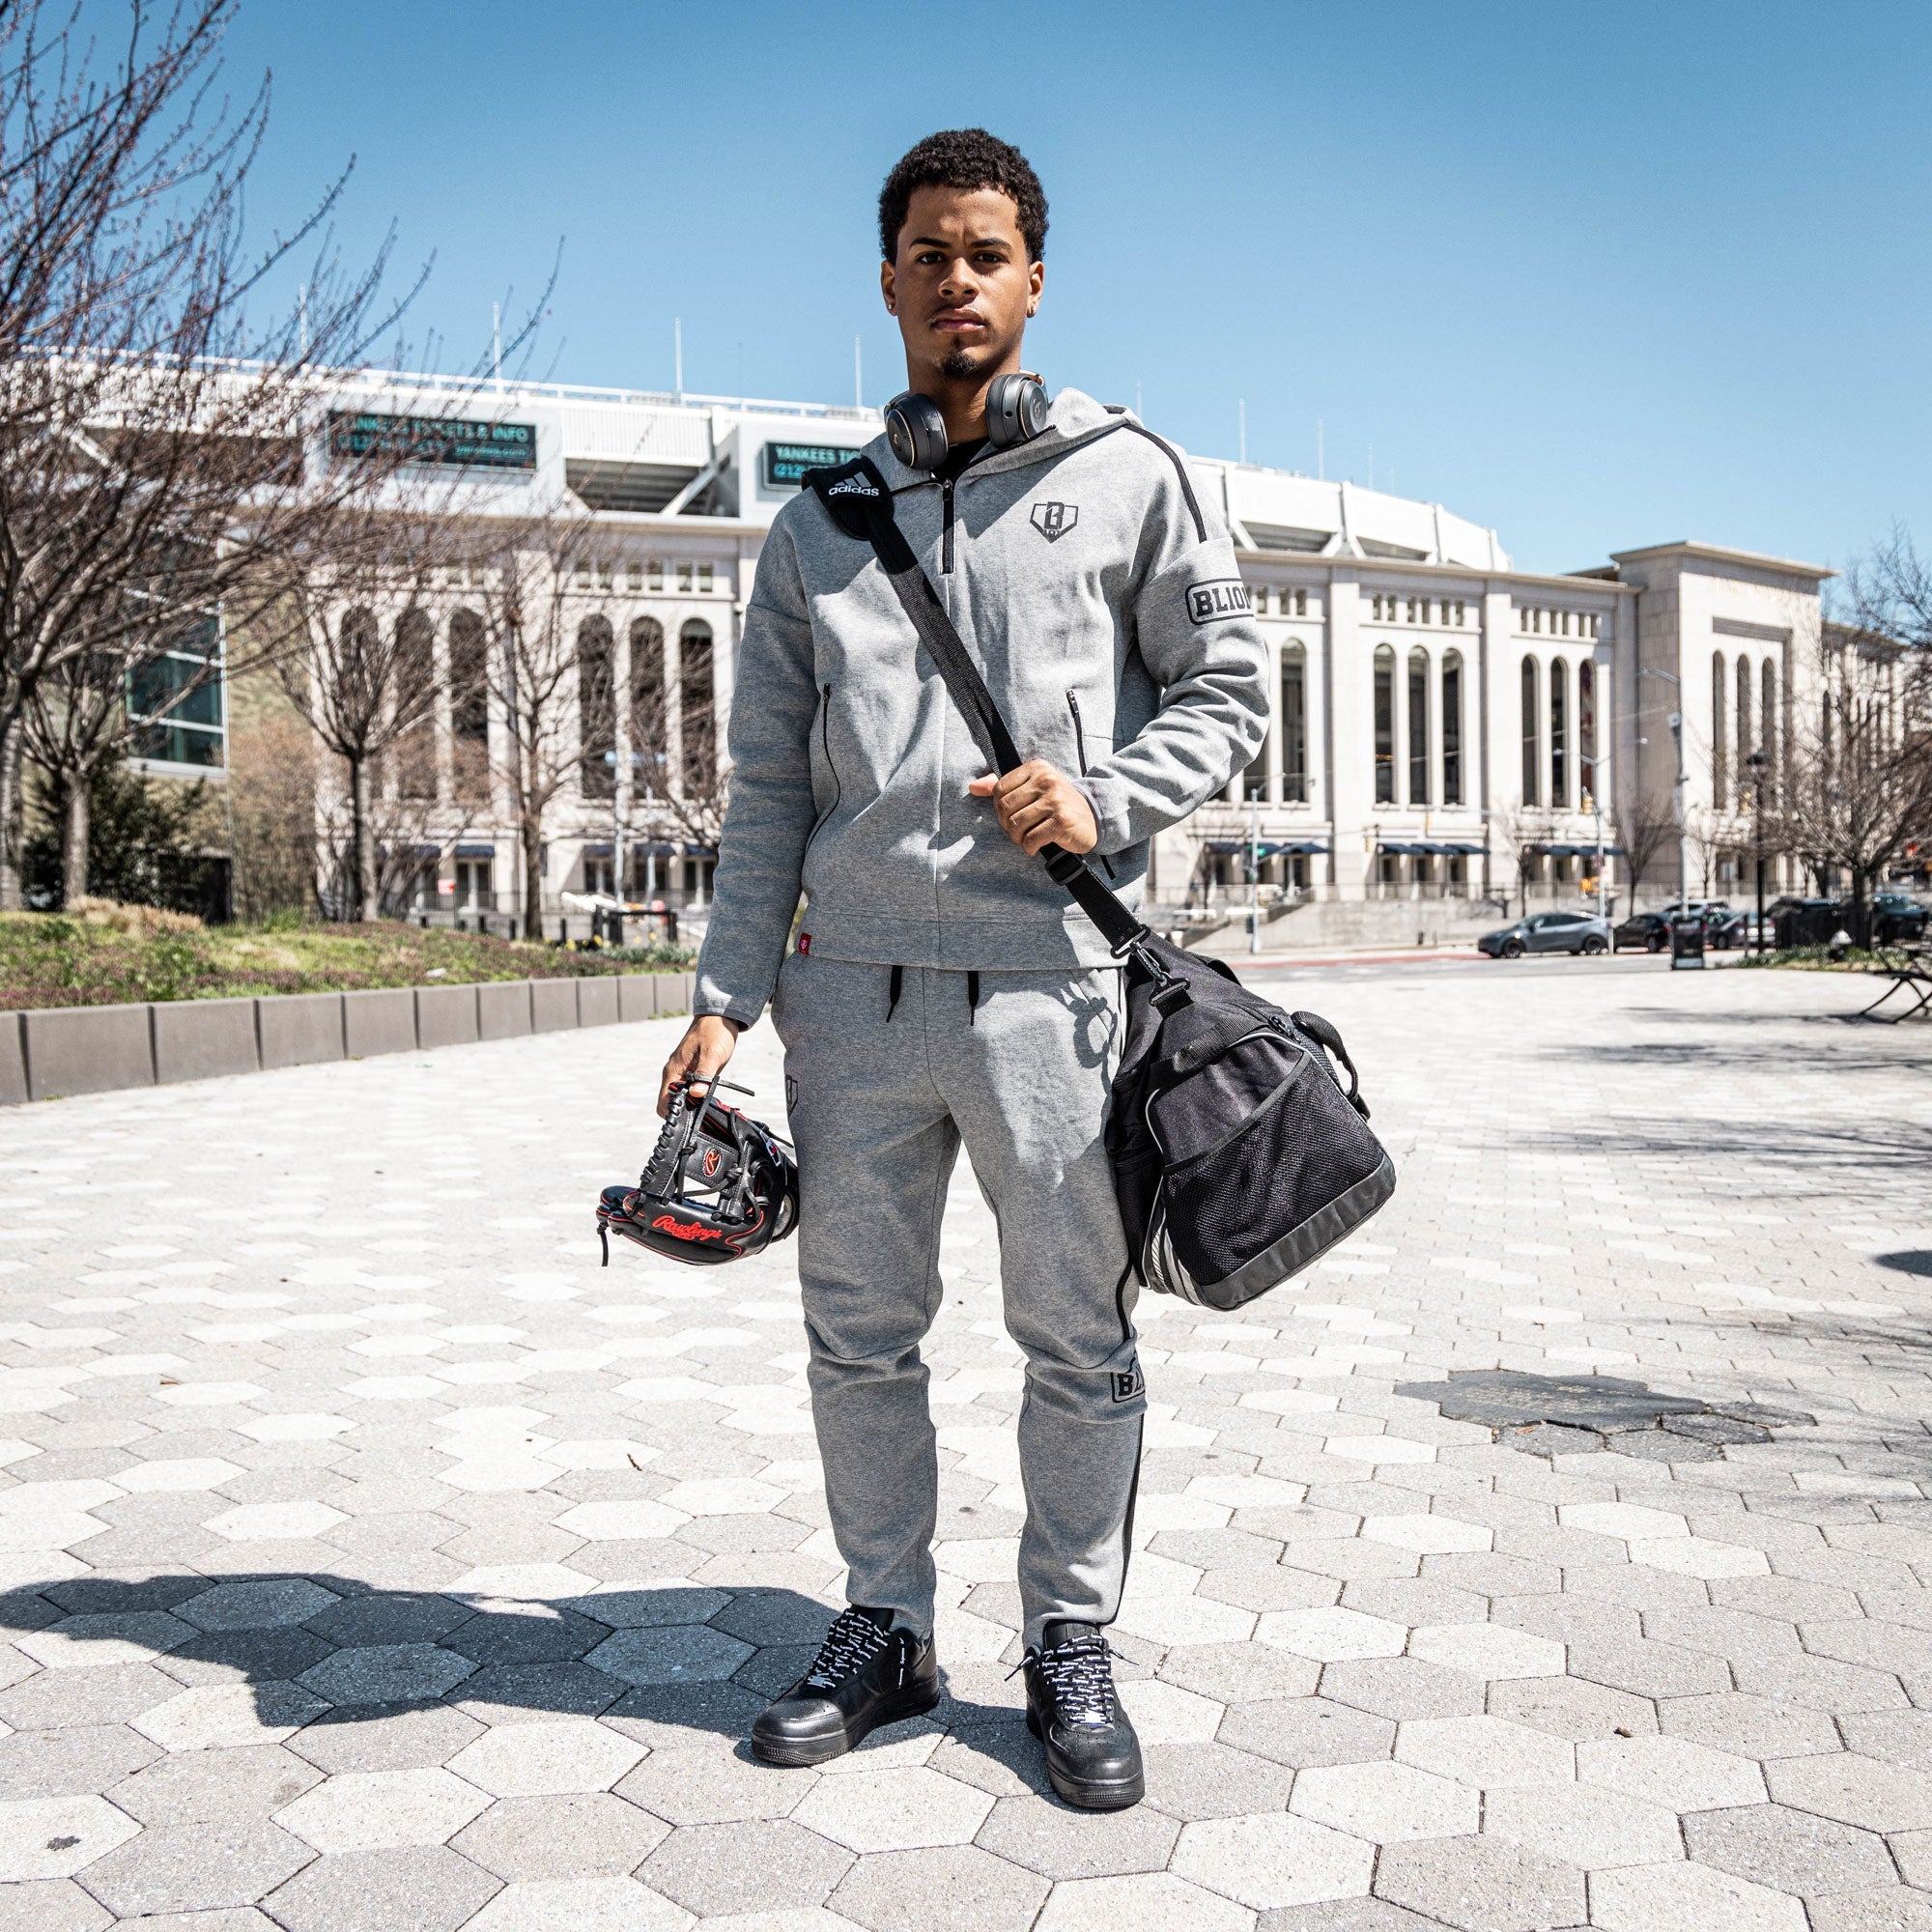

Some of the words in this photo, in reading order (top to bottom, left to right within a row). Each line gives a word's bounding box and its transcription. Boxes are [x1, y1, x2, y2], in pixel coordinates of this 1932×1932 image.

[492, 425, 529, 443] INFO
[776, 445, 836, 464] YANKEES
[828, 485, 880, 497] adidas
[651, 1214, 724, 1241] Rawlings
